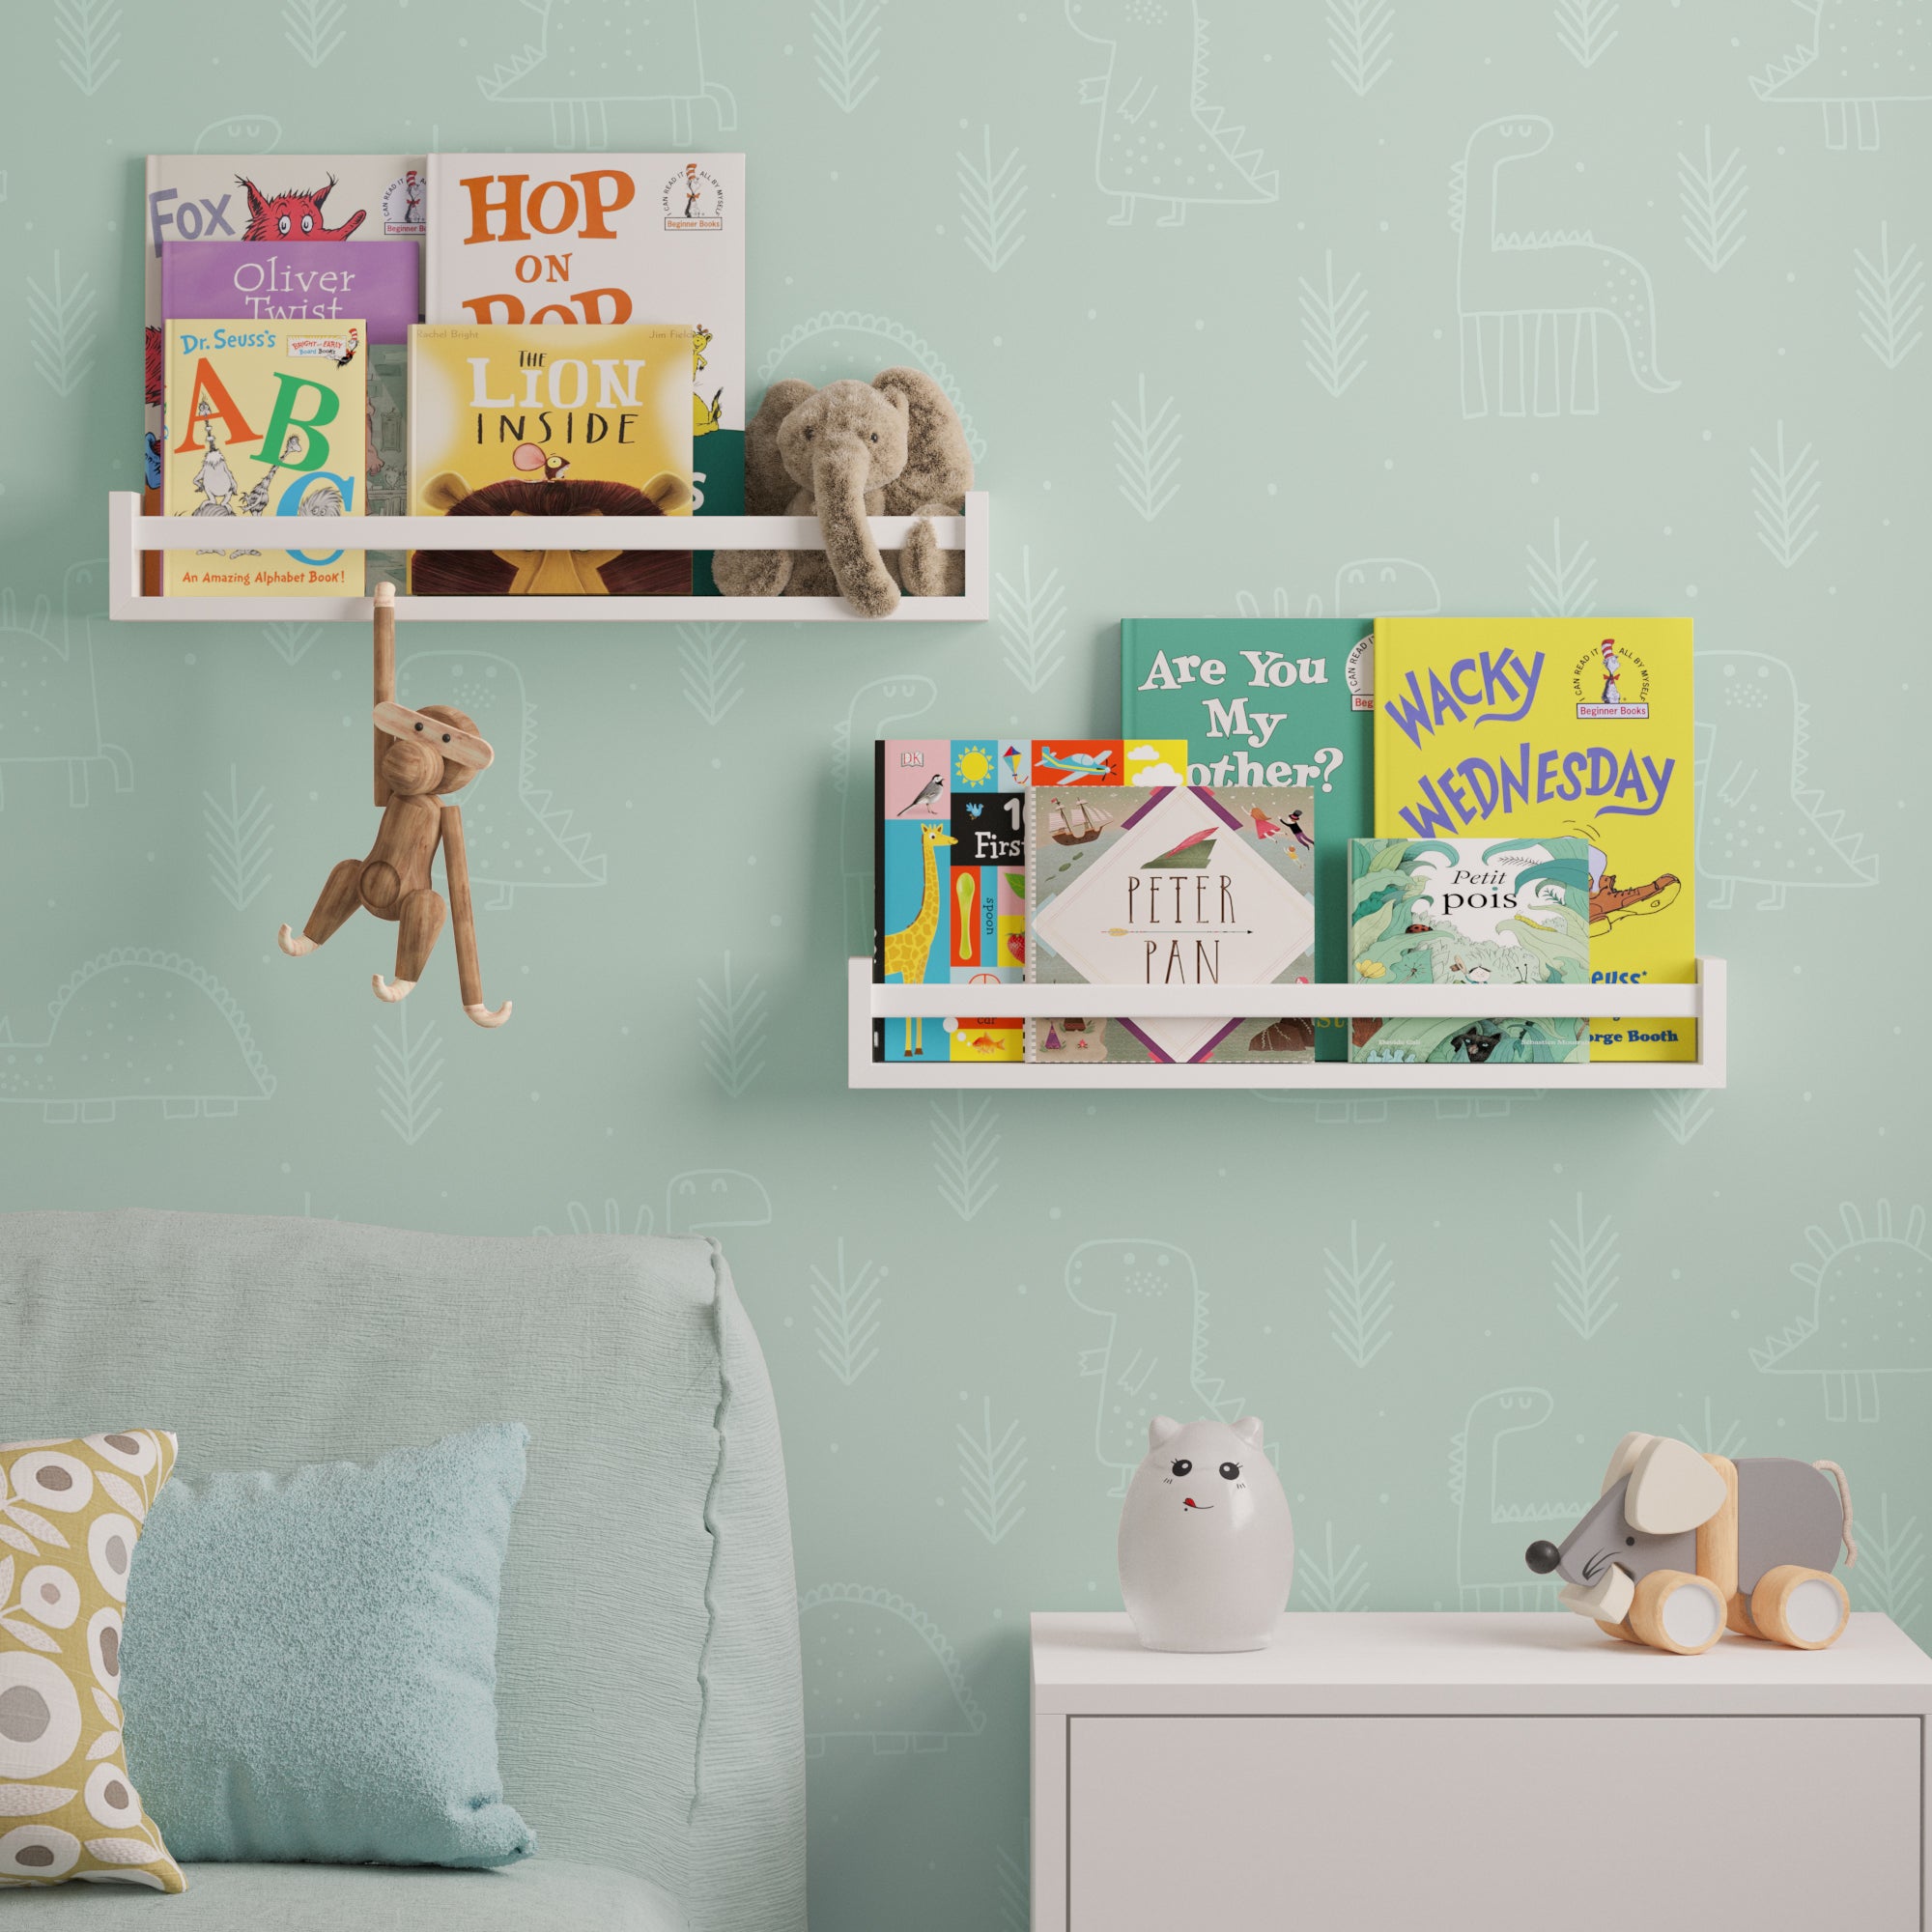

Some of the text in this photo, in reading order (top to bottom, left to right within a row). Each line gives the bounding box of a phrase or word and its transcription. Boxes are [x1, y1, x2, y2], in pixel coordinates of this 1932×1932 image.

[664, 177, 677, 193] READ
[699, 171, 711, 181] ALL
[711, 179, 721, 188] BY
[384, 184, 397, 200] READ
[715, 189, 724, 216] MYSELF
[460, 169, 636, 245] HOP
[386, 224, 417, 233] Beginner
[668, 220, 697, 229] Beginner
[234, 256, 355, 293] Oliver
[515, 253, 573, 283] ON
[245, 296, 343, 319] Twist
[180, 328, 276, 355] Dr. Seuss's
[417, 329, 479, 339] Rachel Bright
[649, 329, 667, 339] Jim
[292, 341, 317, 350] BRIGHT
[518, 350, 547, 367] THE
[467, 357, 645, 409] LION
[477, 412, 639, 444] INSIDE
[183, 572, 198, 582] An
[202, 572, 250, 585] Amazing
[255, 572, 305, 585] Alphabet
[1350, 641, 1368, 664] READ
[1619, 647, 1633, 659] ALL
[1634, 657, 1645, 668] BY
[1137, 649, 1328, 691] Are You
[1575, 654, 1590, 675] READ
[1349, 668, 1357, 686] CAN
[1574, 678, 1582, 696] CAN
[1639, 669, 1650, 702] MYSELF
[1384, 647, 1545, 751] WACKY
[1580, 706, 1646, 716] Beginner Books
[1202, 697, 1288, 748] My
[903, 752, 921, 765] DK
[1187, 747, 1344, 793] other?
[1398, 742, 1675, 838] WEDNESDAY
[975, 832, 1024, 859] Firs
[1451, 870, 1507, 885] Petit
[1128, 875, 1236, 923] PETER
[1441, 887, 1518, 915] pois
[983, 897, 994, 935] spoon
[1144, 940, 1219, 984] PAN
[1628, 1030, 1679, 1042] Booth
